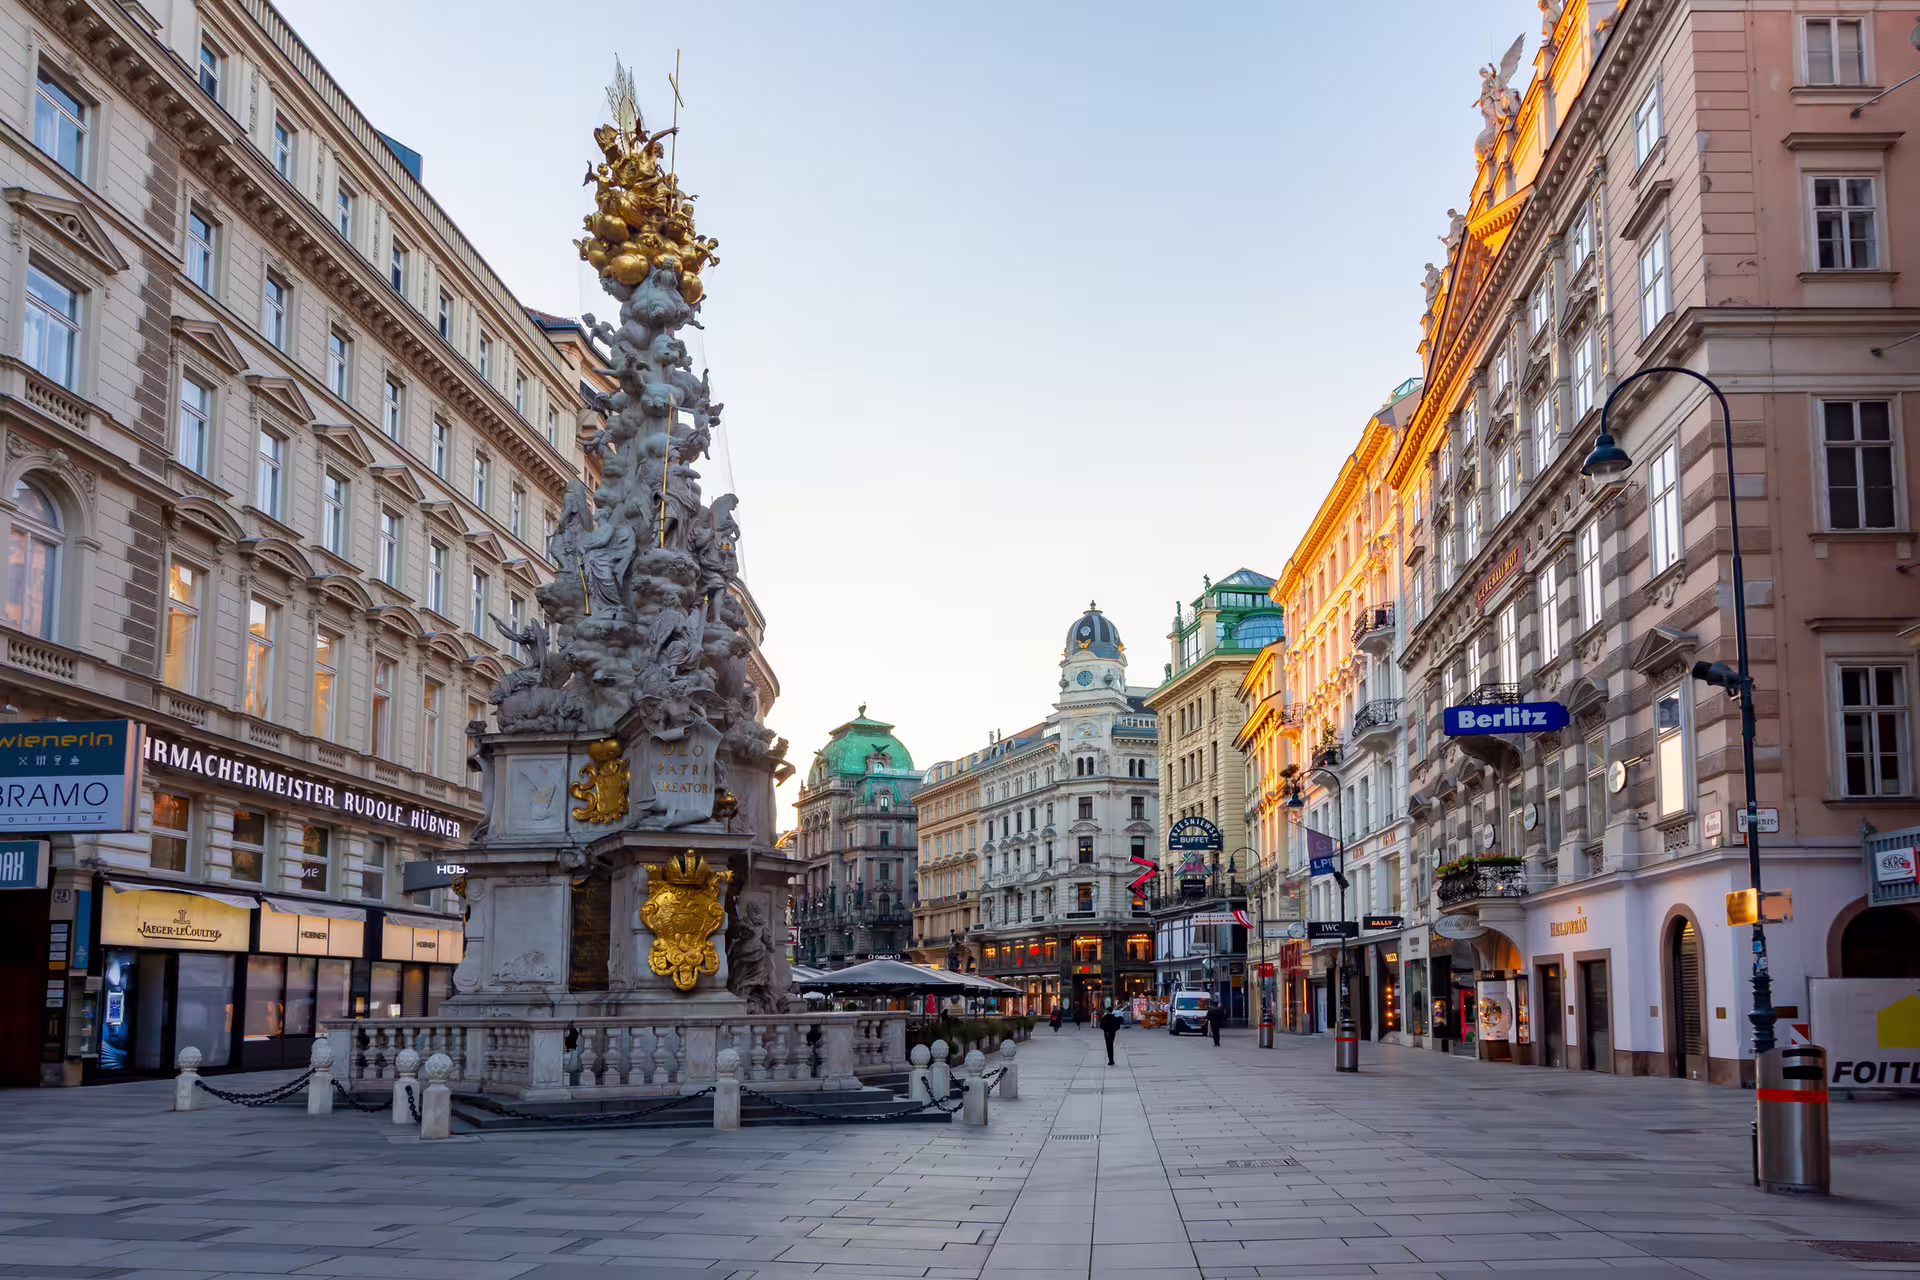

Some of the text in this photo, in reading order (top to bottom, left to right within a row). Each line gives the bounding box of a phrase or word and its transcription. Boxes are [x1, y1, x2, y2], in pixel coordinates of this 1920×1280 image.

[1458, 707, 1547, 729] Berlitz
[0, 782, 108, 808] RAMO
[344, 792, 402, 823] RUDOLF
[411, 809, 460, 838] HÜBNER
[1180, 836, 1210, 844] BUFFET
[1321, 924, 1340, 932] IWC
